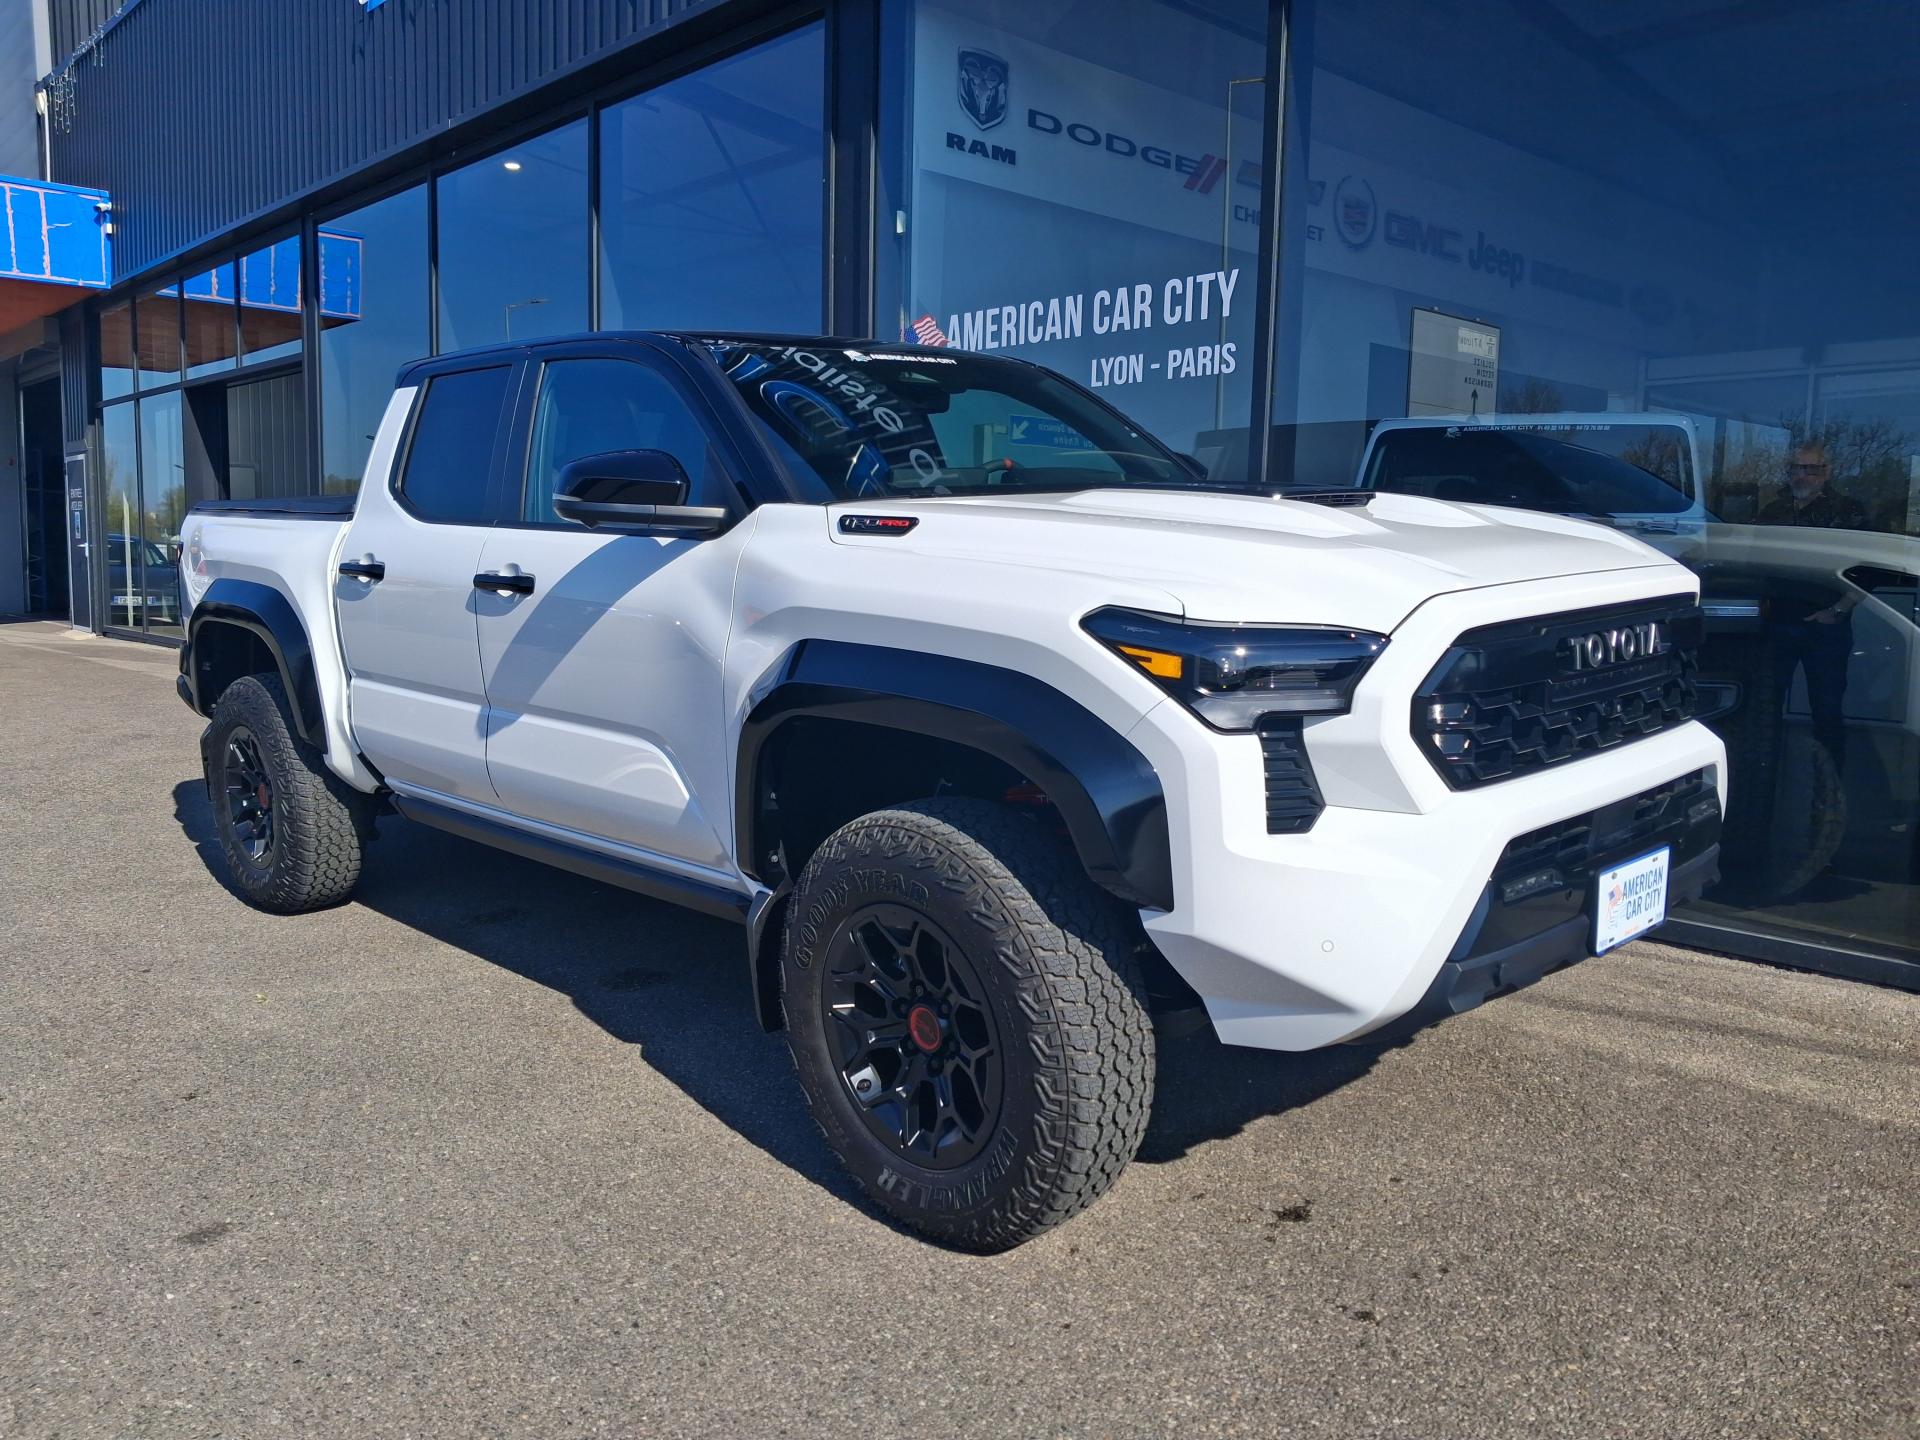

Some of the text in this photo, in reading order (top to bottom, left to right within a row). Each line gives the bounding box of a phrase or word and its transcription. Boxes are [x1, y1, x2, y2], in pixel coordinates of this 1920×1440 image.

[946, 132, 1016, 166] RAM
[1027, 108, 1204, 177] DODGE
[1384, 212, 1462, 263] GMC
[1468, 231, 1525, 289] Jeep
[947, 268, 1239, 352] AMERICAN CAR CITY
[1091, 354, 1143, 387] LYON
[1167, 343, 1236, 380] PARIS
[1568, 623, 1662, 670] TOYOTA
[1622, 866, 1664, 901] AMERICAN
[1626, 895, 1643, 921] CAR
[1644, 887, 1662, 912] CITY
[794, 866, 929, 969] GOODYEAR
[876, 1126, 1019, 1210] WRANGLER
